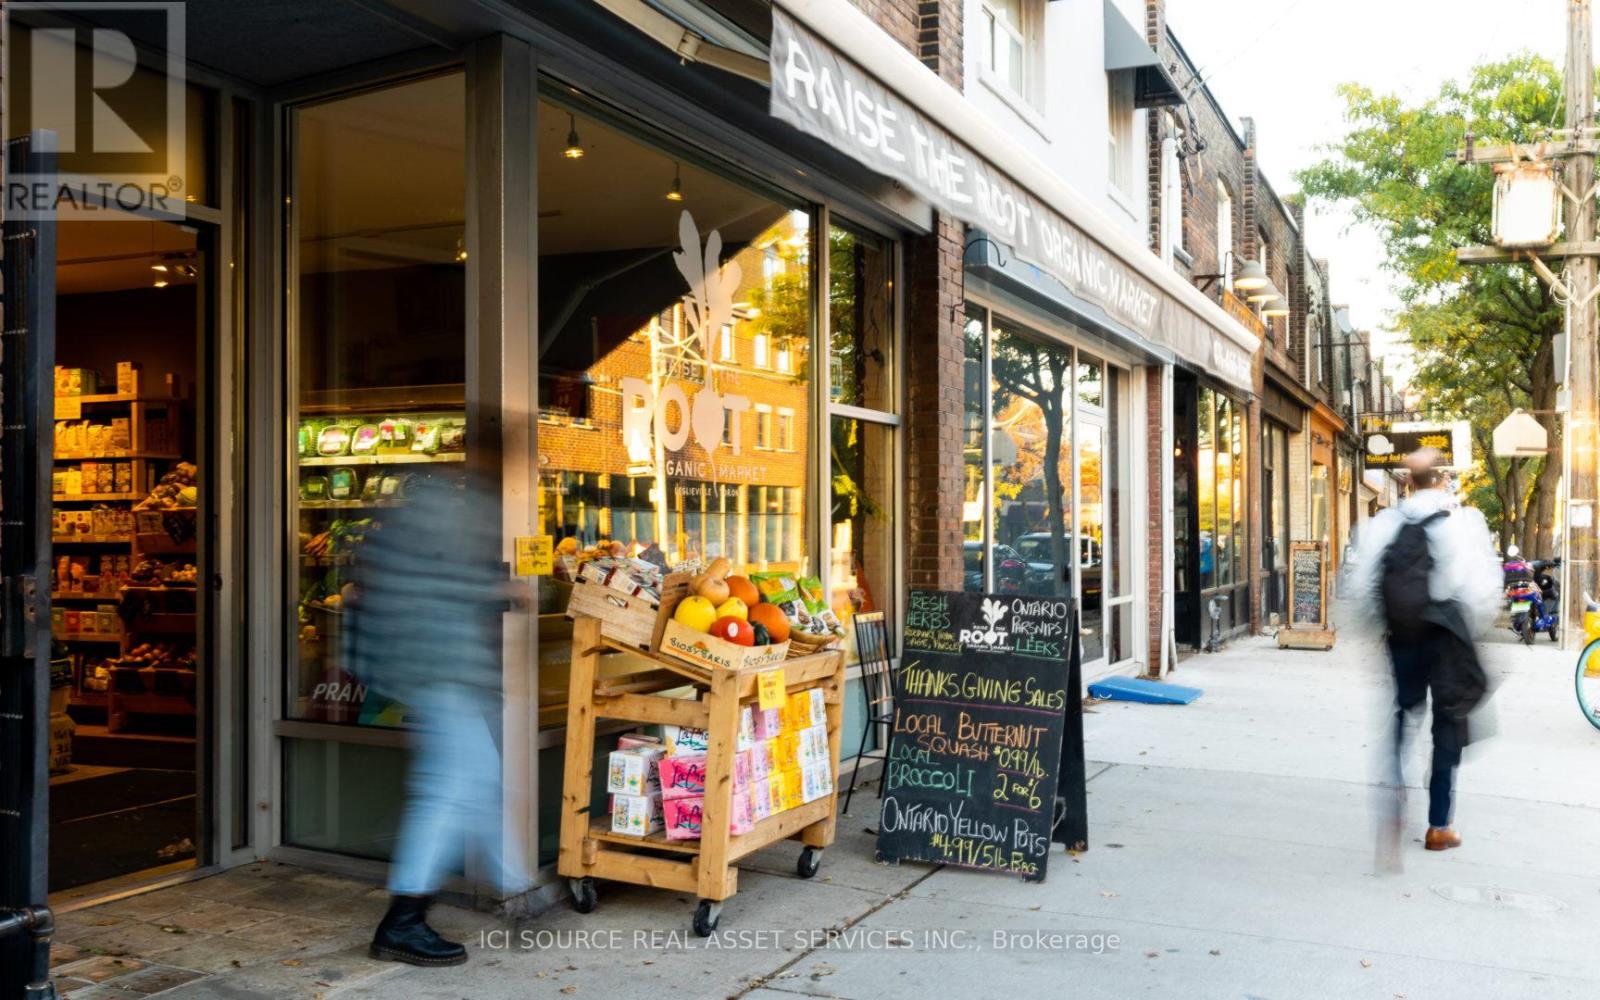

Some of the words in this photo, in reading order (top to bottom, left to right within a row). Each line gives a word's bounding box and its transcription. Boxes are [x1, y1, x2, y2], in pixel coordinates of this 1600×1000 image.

[785, 38, 906, 162] RAISE
[910, 124, 973, 204] THE
[974, 171, 1031, 247] ROOT
[1040, 219, 1107, 294] ORGANIC
[1108, 268, 1157, 328] MARKET
[650, 459, 706, 478] GANIC
[719, 465, 767, 480] MARKET
[911, 591, 949, 610] FRESH
[1011, 598, 1067, 618] ONTARIO
[906, 611, 950, 630] HERBS
[959, 629, 1008, 646] ROOT
[1015, 639, 1060, 657] LEEKS
[1024, 676, 1066, 709] SALES
[895, 707, 947, 736] LOCAL
[957, 711, 1049, 749] BUTTERNUT
[890, 738, 941, 765] LOCAL
[917, 734, 989, 761] SQUASH
[887, 761, 976, 797] BROCCOLI
[993, 773, 1009, 801] 2
[881, 796, 949, 833] ONTARIO
[949, 800, 1009, 843] YELLOW
[1013, 818, 1048, 857] POTS
